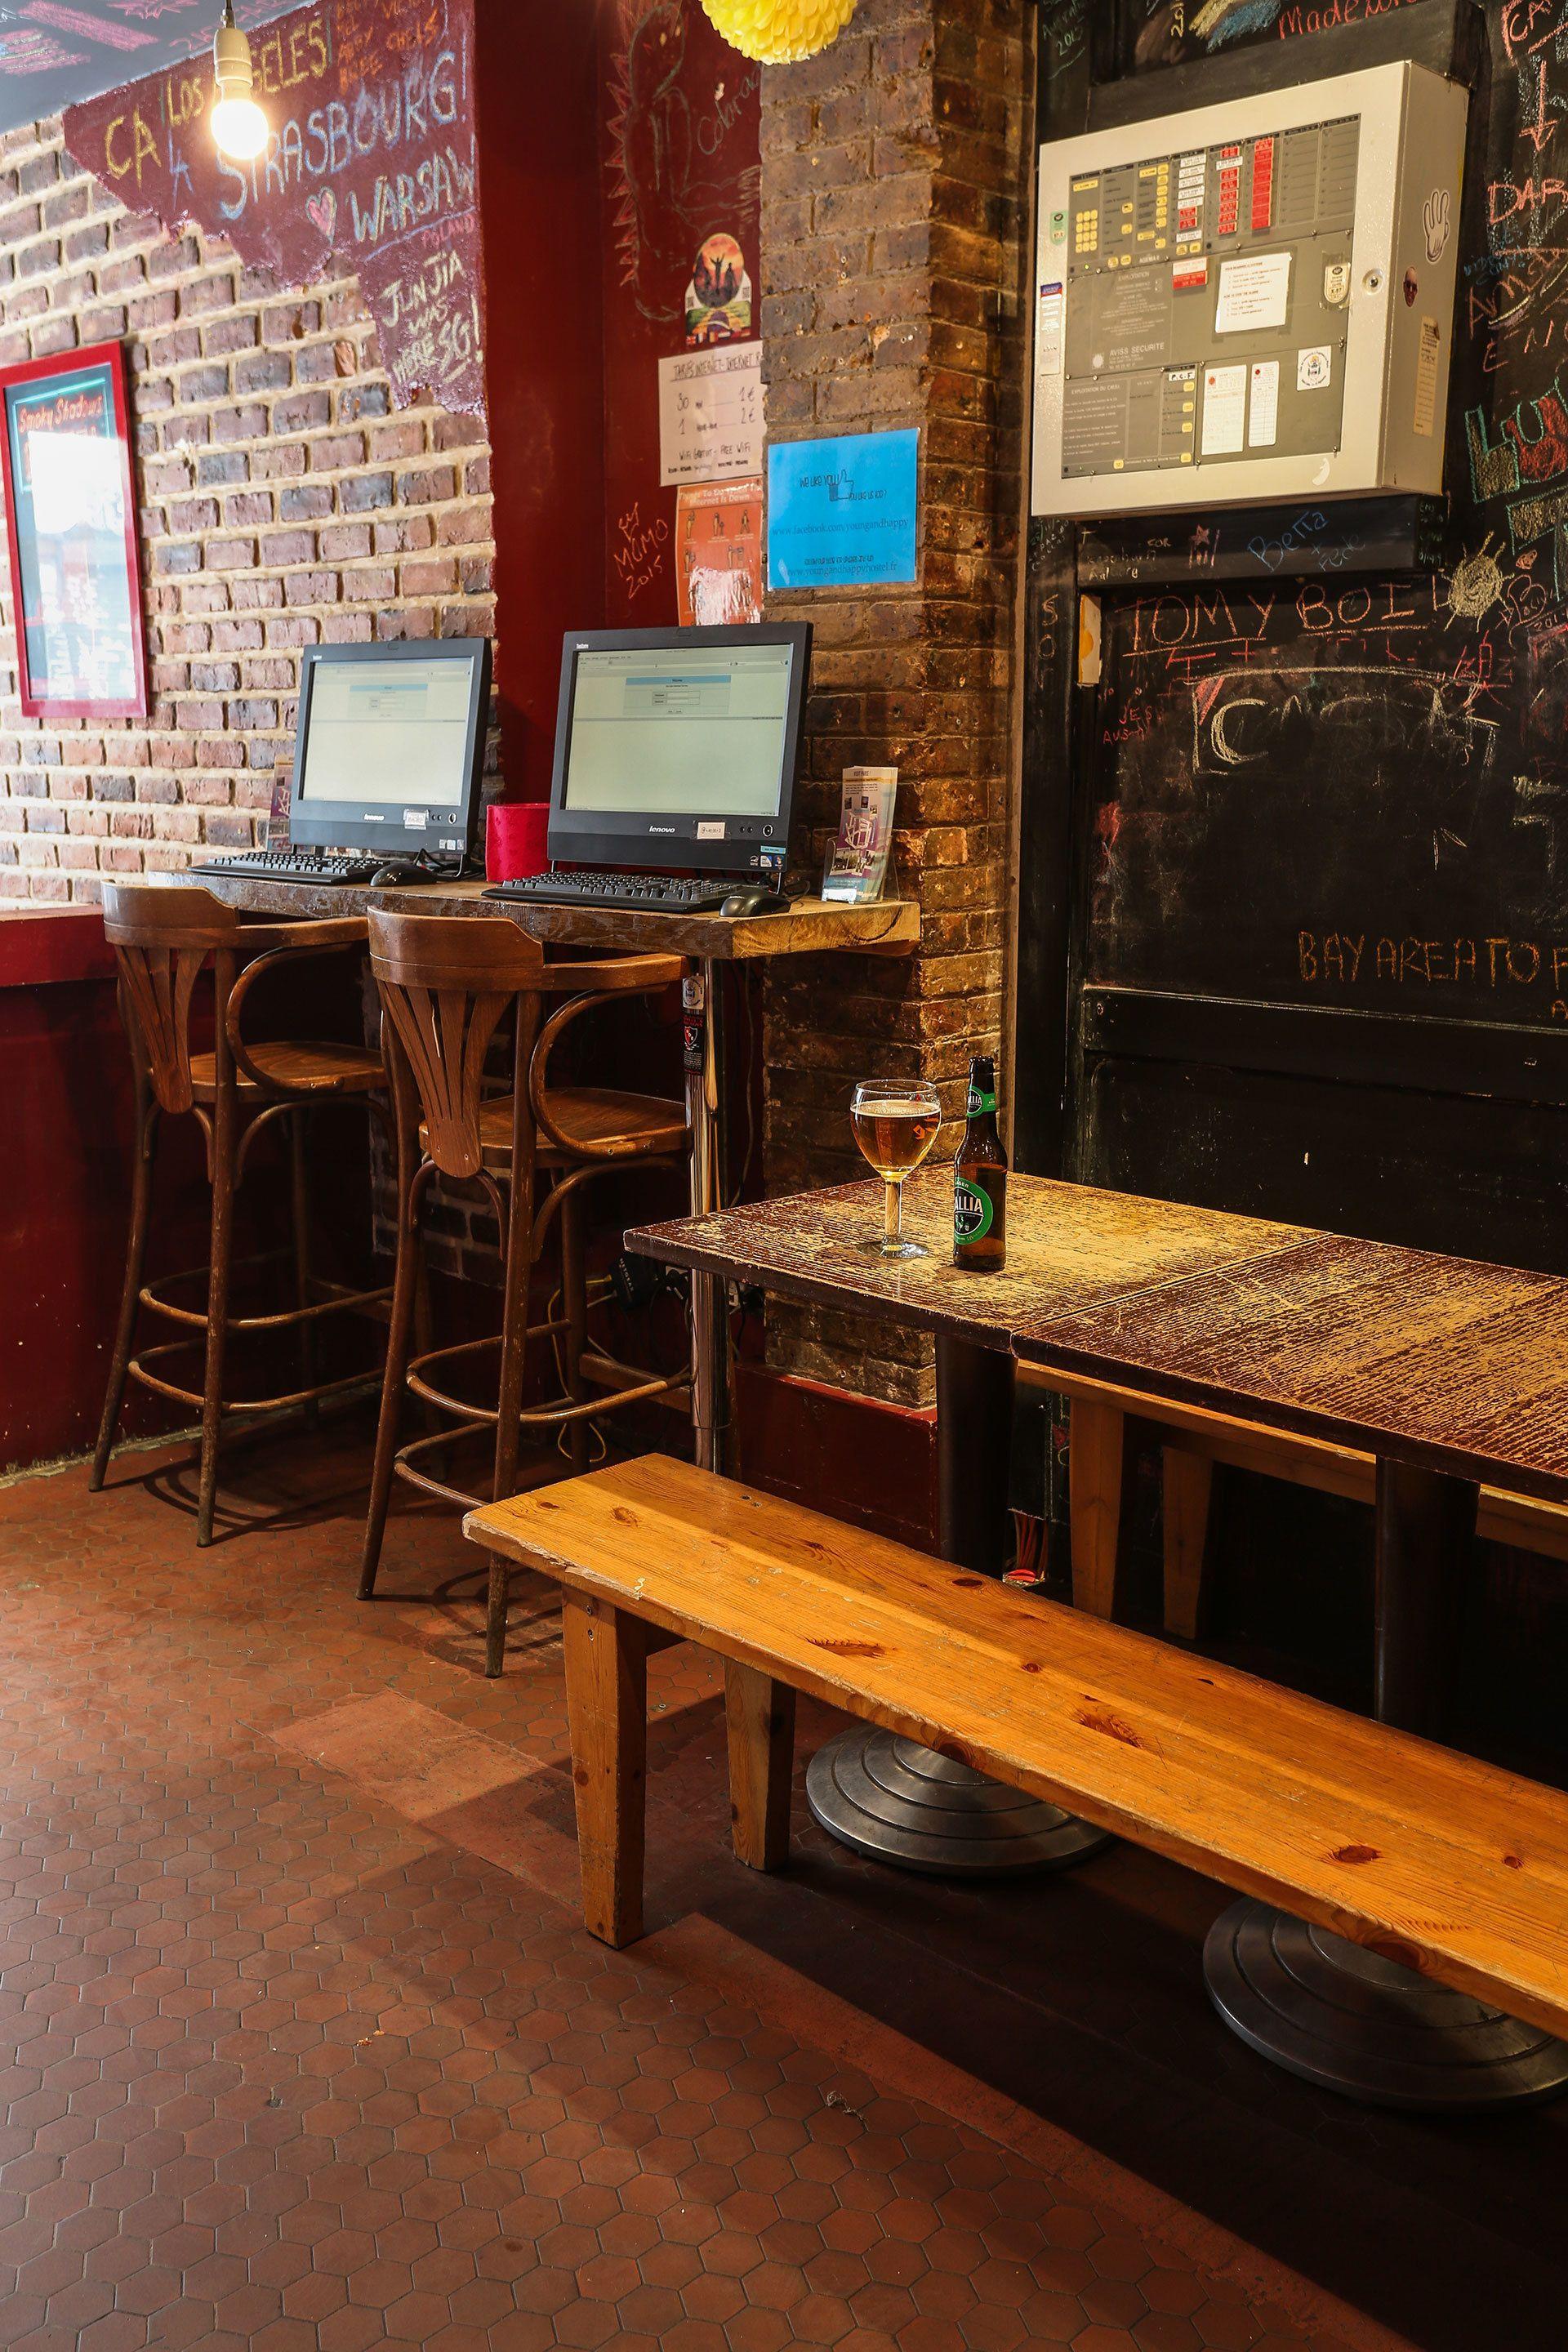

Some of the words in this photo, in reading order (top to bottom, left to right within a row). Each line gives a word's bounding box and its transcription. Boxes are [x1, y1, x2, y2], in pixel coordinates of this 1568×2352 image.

[167, 77, 204, 127] LOS
[345, 132, 477, 244] WARSAW
[1114, 588, 1276, 652] TOMY
[648, 825, 676, 834] lenovo
[1298, 930, 1365, 982] BAY
[954, 1196, 984, 1215] ALLIA
